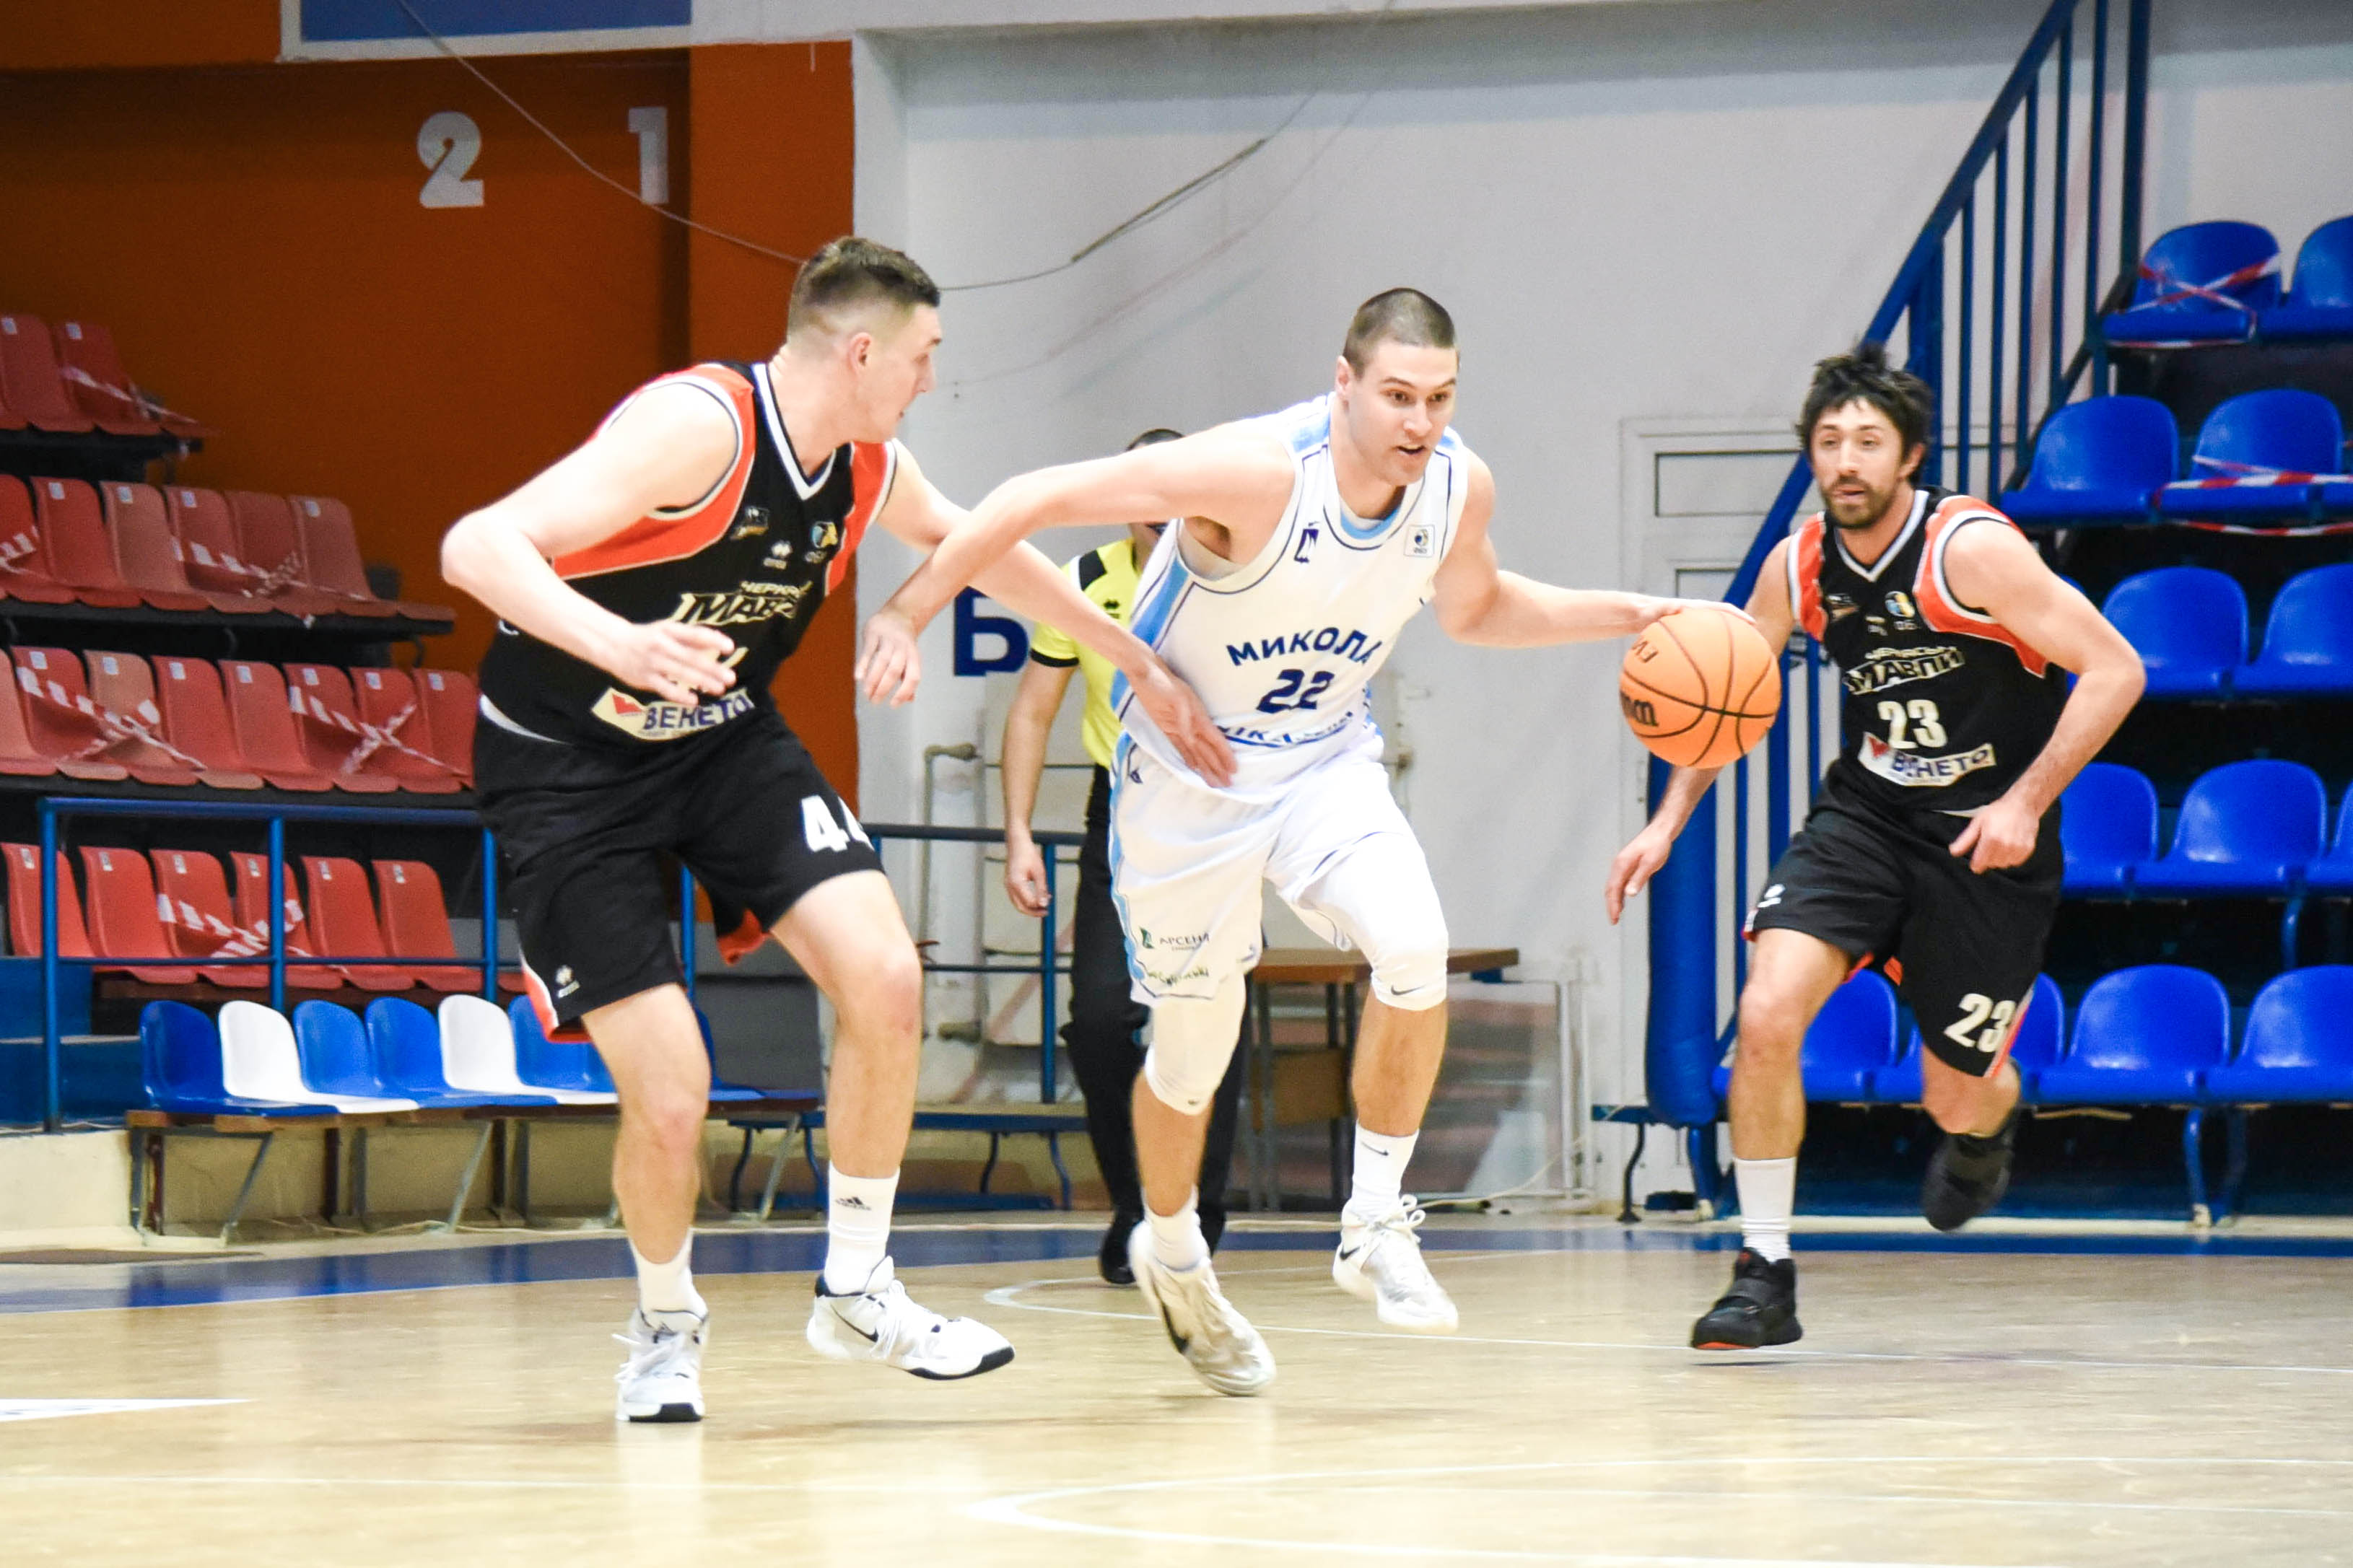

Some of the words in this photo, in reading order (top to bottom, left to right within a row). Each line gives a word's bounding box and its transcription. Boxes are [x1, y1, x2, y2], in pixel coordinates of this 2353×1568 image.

[417, 112, 484, 209] 2
[628, 107, 669, 204] 1
[1256, 668, 1335, 714] 22
[1877, 699, 1947, 750] 23
[1942, 992, 2017, 1053] 23
